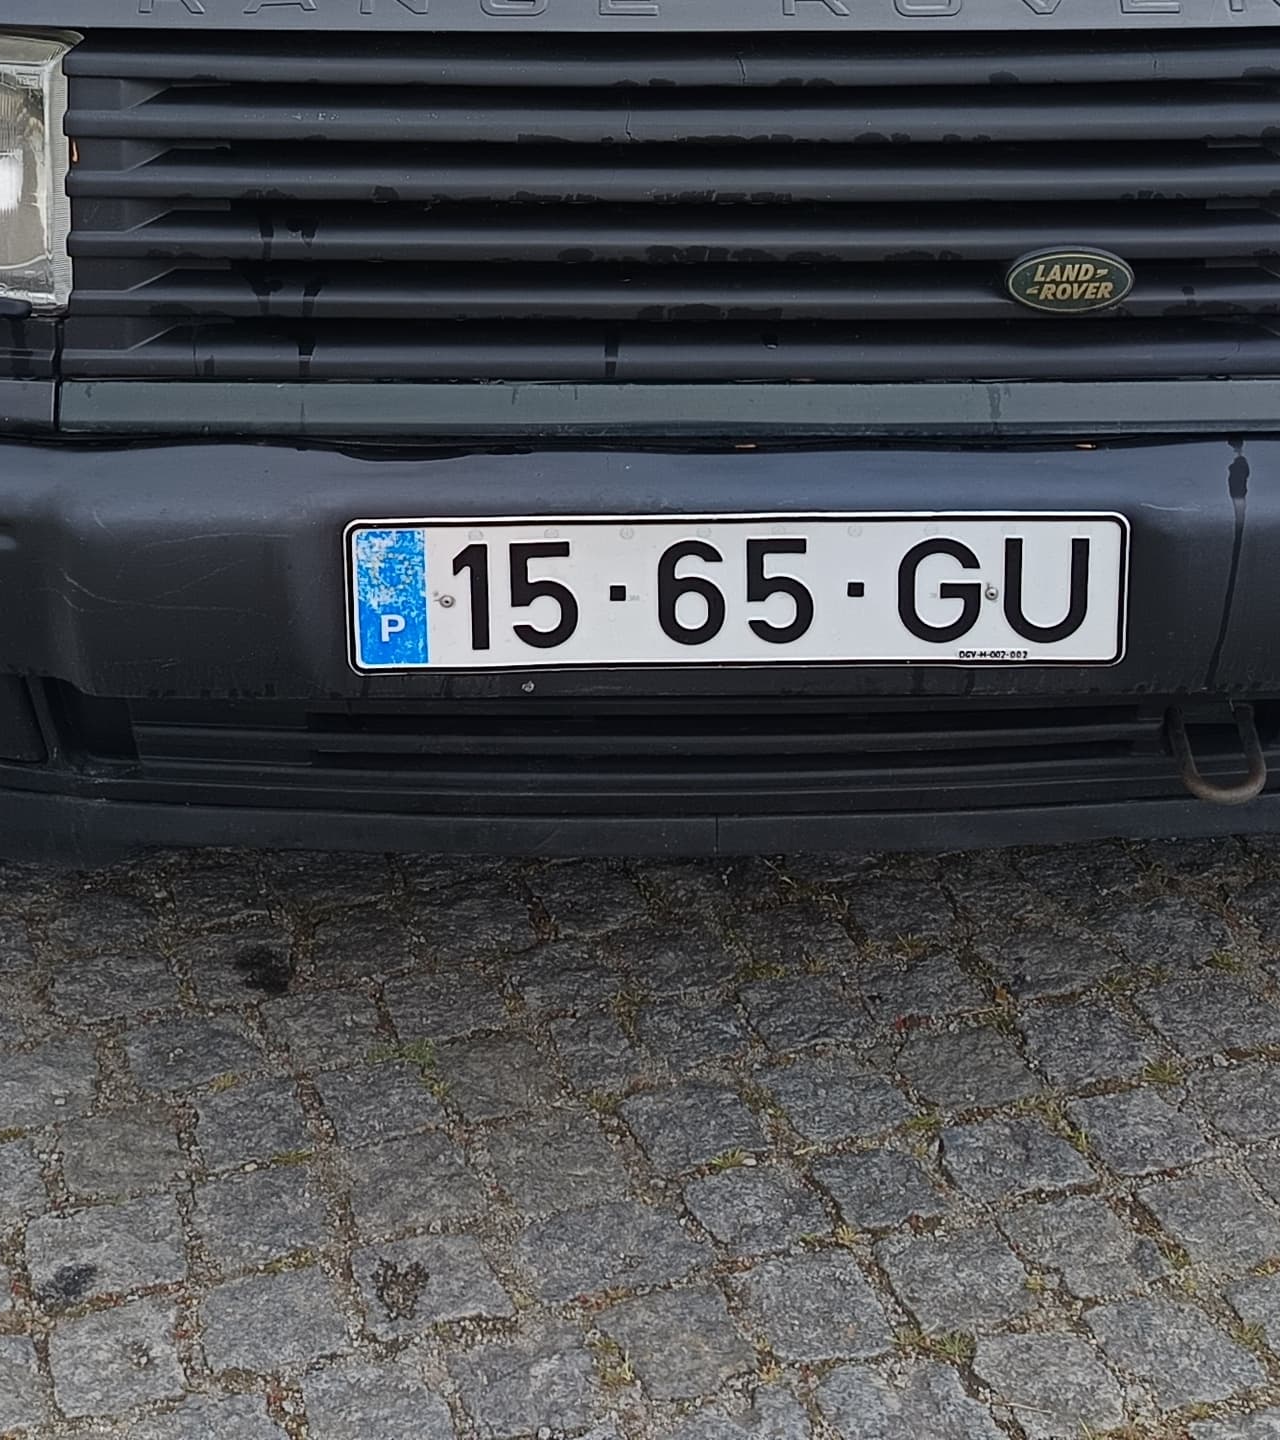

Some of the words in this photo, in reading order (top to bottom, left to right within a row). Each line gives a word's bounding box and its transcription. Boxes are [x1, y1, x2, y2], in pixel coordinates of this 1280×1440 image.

[1033, 263, 1095, 282] LAND
[1038, 281, 1114, 301] ROVER
[381, 614, 406, 642] P
